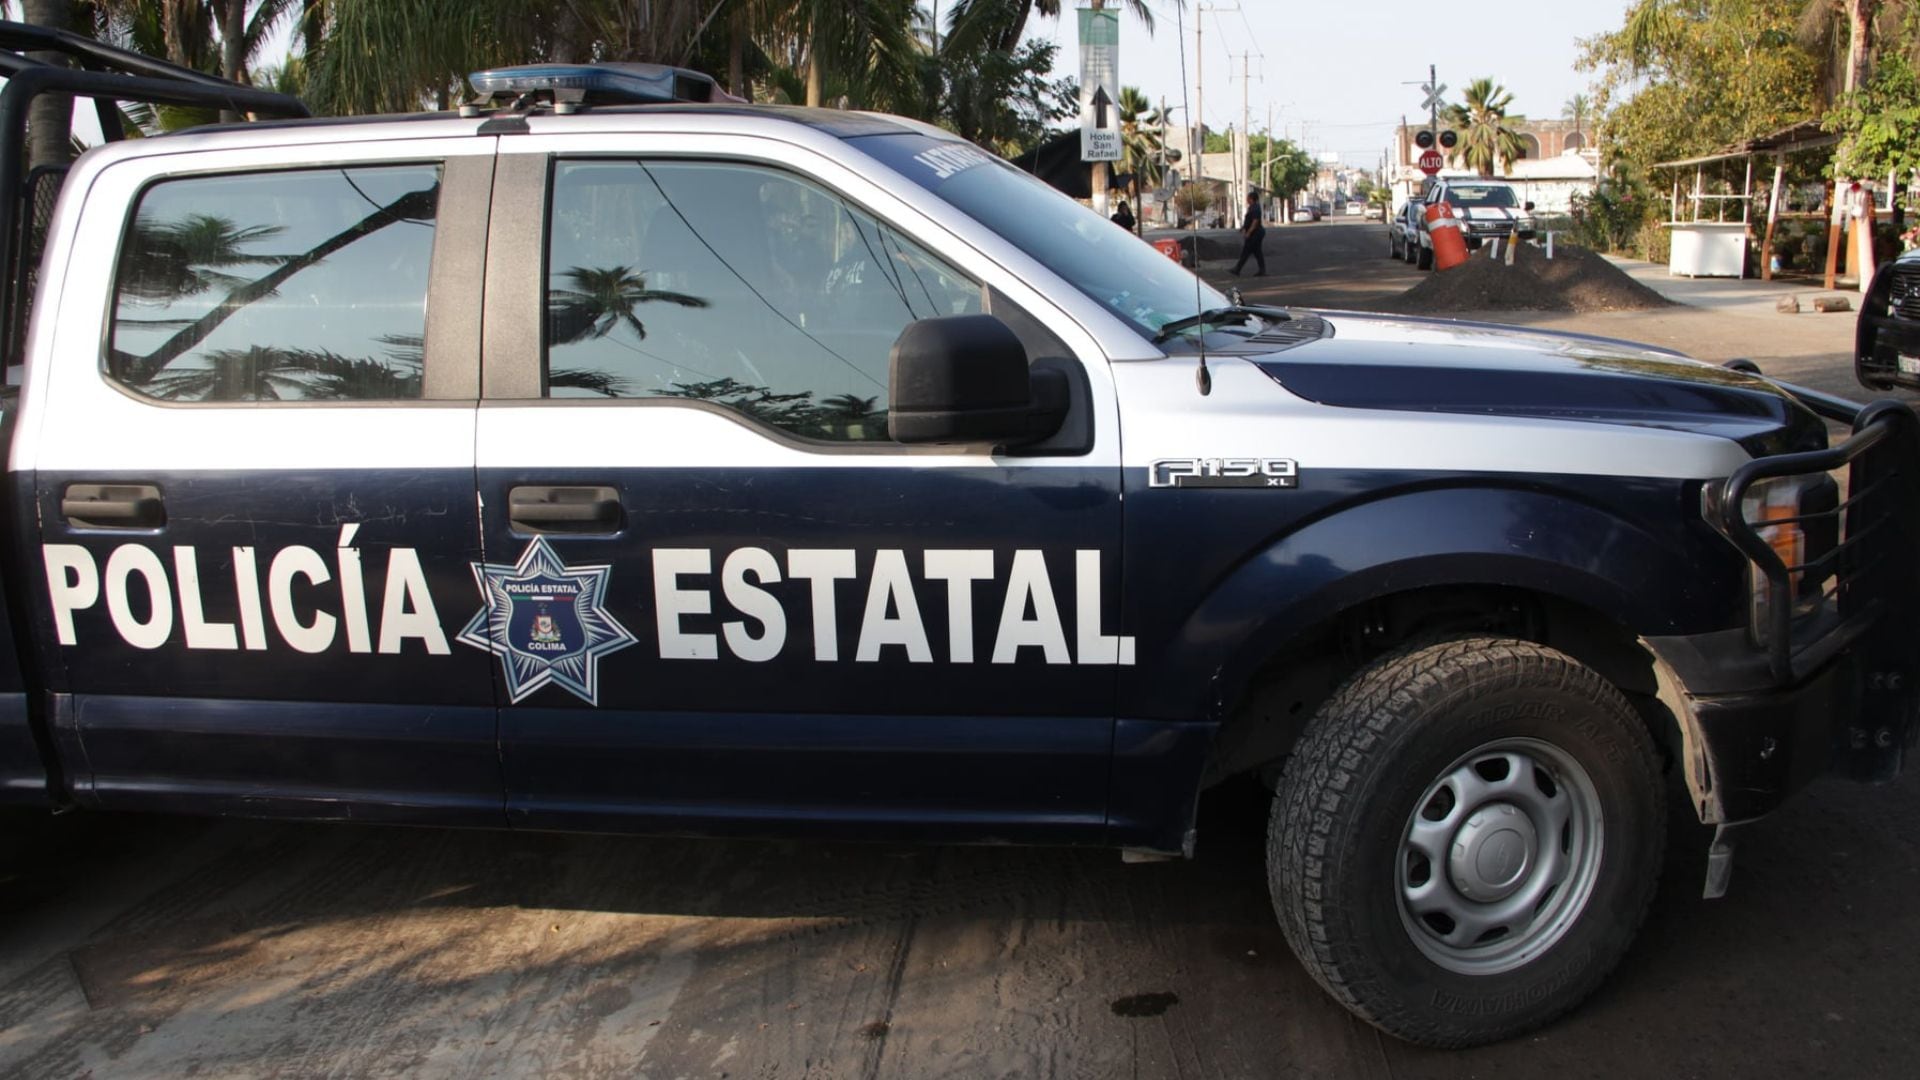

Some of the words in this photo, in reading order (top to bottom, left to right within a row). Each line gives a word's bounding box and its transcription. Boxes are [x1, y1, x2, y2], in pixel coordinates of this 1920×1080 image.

[1090, 133, 1115, 141] Hotel
[1093, 141, 1112, 150] San
[1088, 149, 1118, 158] Rafael
[1420, 156, 1442, 168] ALTO
[1267, 478, 1290, 486] XL
[505, 582, 540, 593] POLICÍA
[541, 584, 579, 594] ESTATAL
[42, 523, 452, 655] POLICÍA
[652, 546, 1136, 665] ESTATAL
[528, 642, 567, 651] COLIMA
